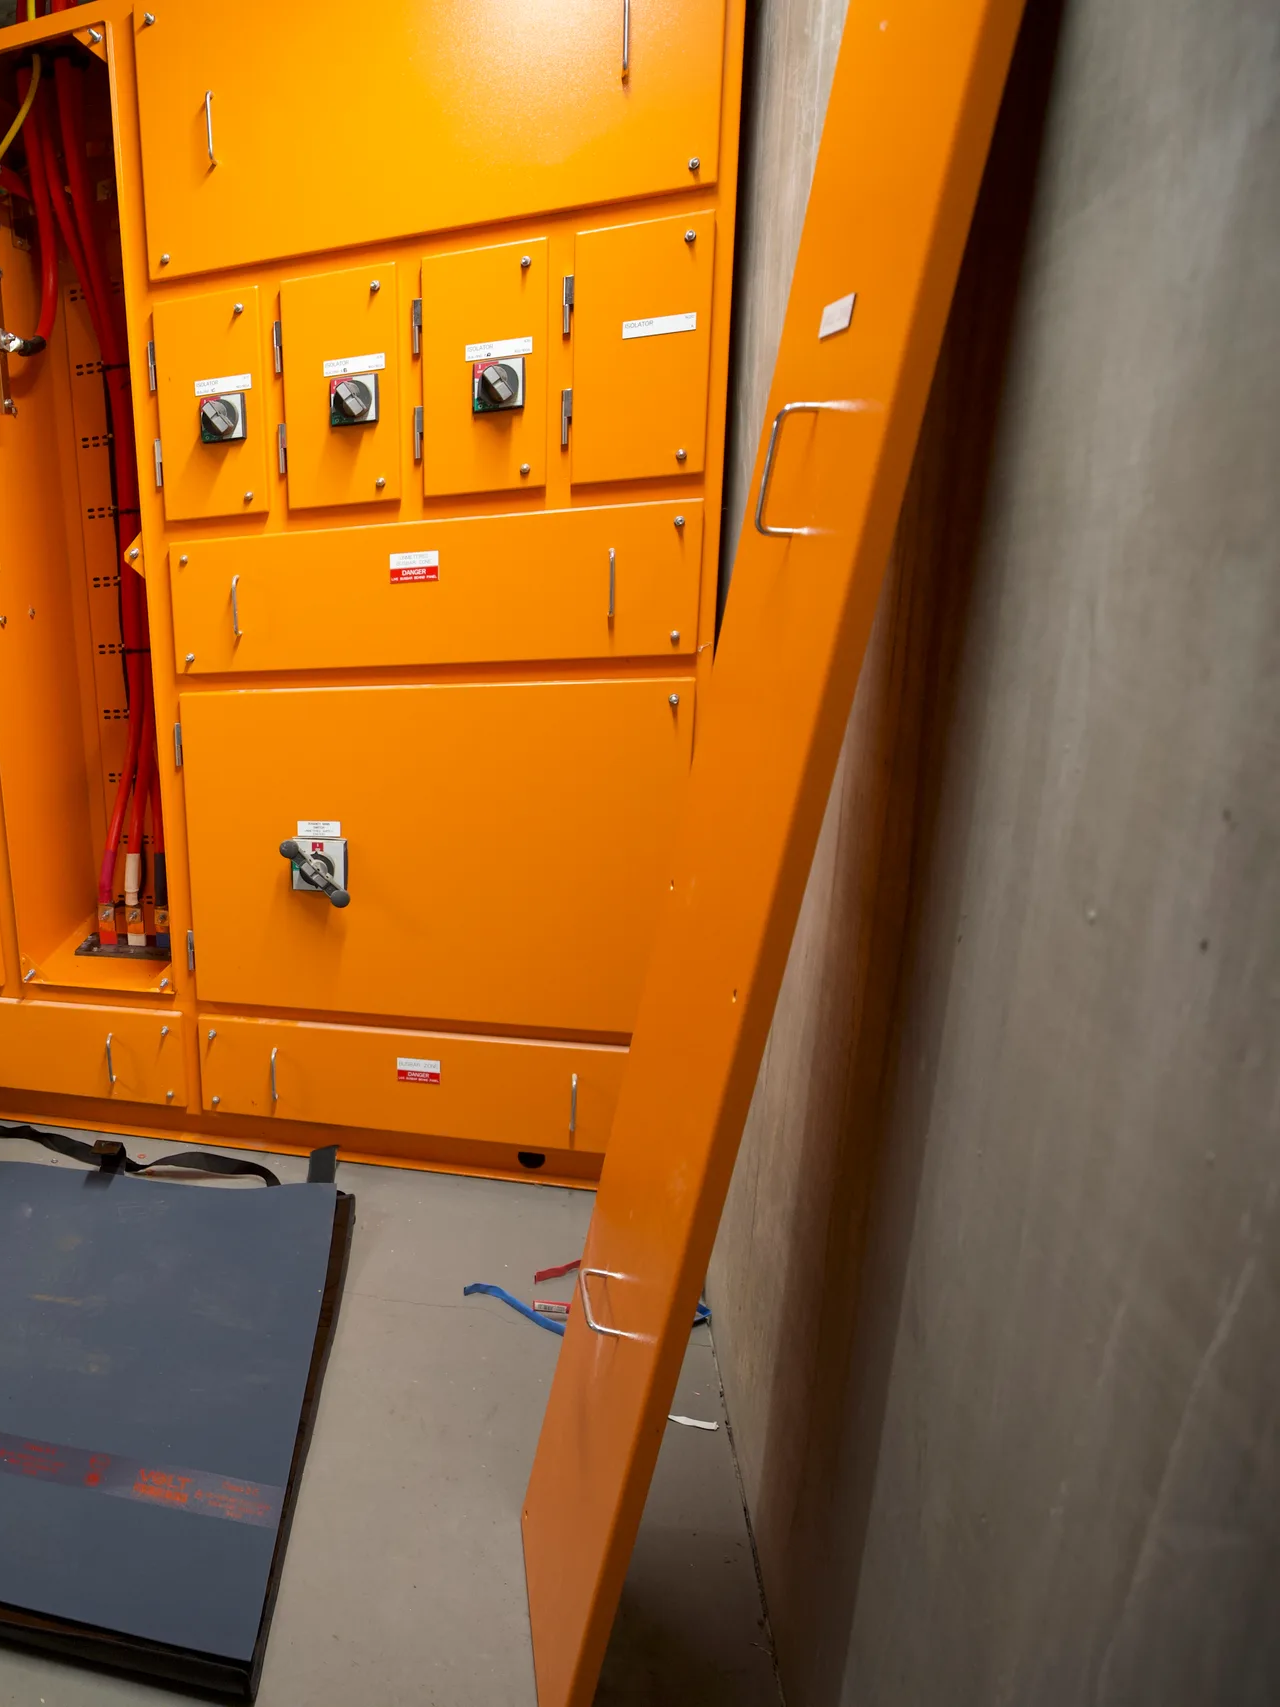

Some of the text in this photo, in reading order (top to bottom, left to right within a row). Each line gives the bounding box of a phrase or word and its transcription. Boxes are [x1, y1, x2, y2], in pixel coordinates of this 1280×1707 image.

[624, 319, 654, 330] ISOLATOR
[467, 343, 494, 352] ISOLATOR
[324, 360, 350, 369] ISOLATOR
[196, 380, 219, 388] ISOLATOR
[401, 568, 427, 577] DANGER
[407, 1071, 431, 1079] DANGER
[139, 1467, 193, 1491] VOLT
